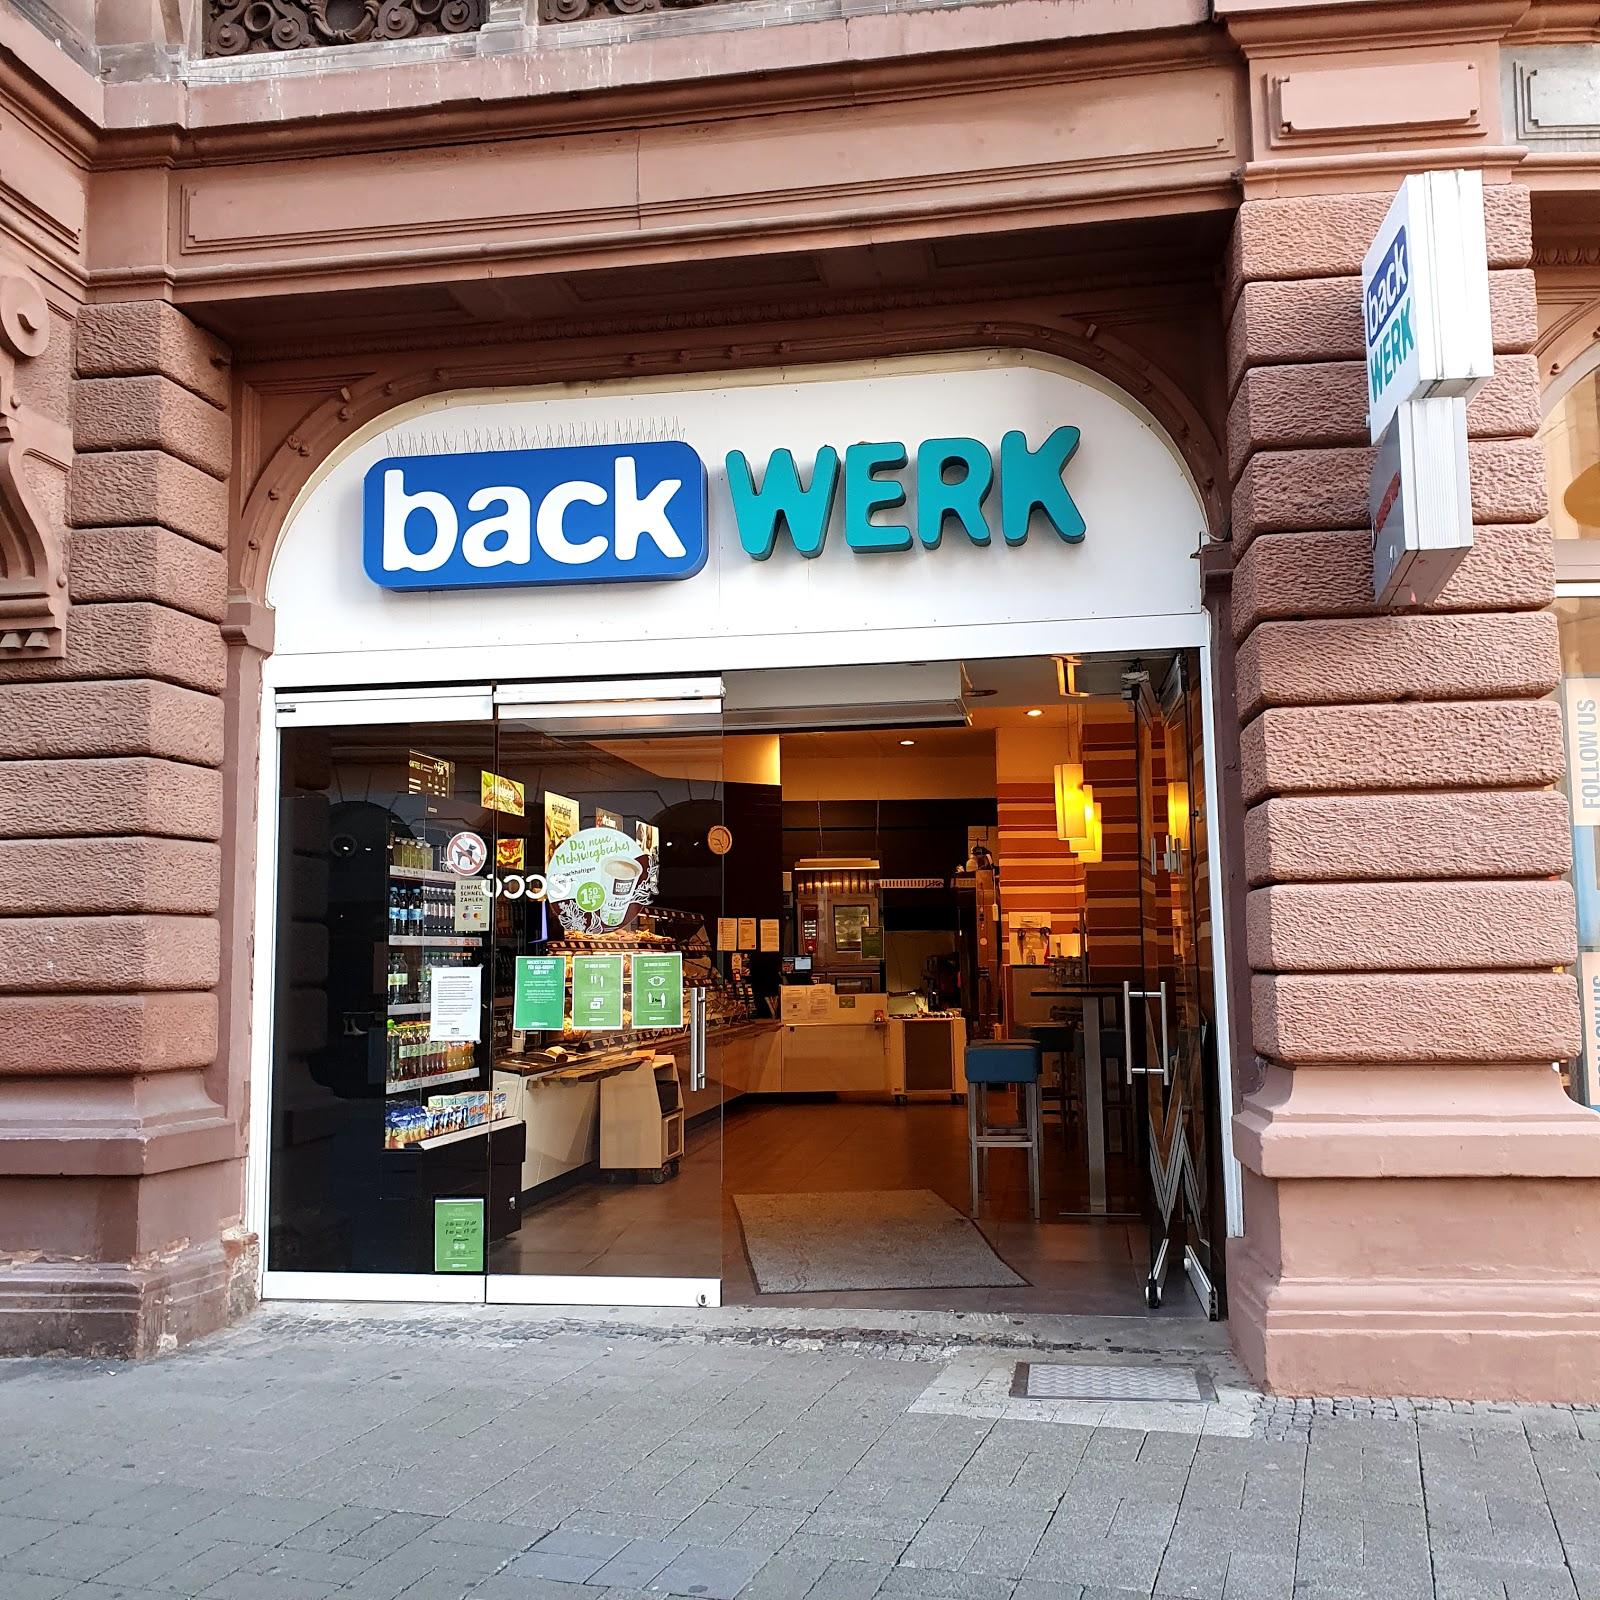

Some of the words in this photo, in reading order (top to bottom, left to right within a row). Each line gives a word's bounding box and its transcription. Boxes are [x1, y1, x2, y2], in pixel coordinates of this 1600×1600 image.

[1368, 242, 1407, 338] back
[1370, 297, 1414, 403] WERK
[381, 456, 686, 572] back
[724, 425, 1087, 561] WERK
[1577, 699, 1596, 726] US
[1579, 730, 1600, 809] FOLLOW
